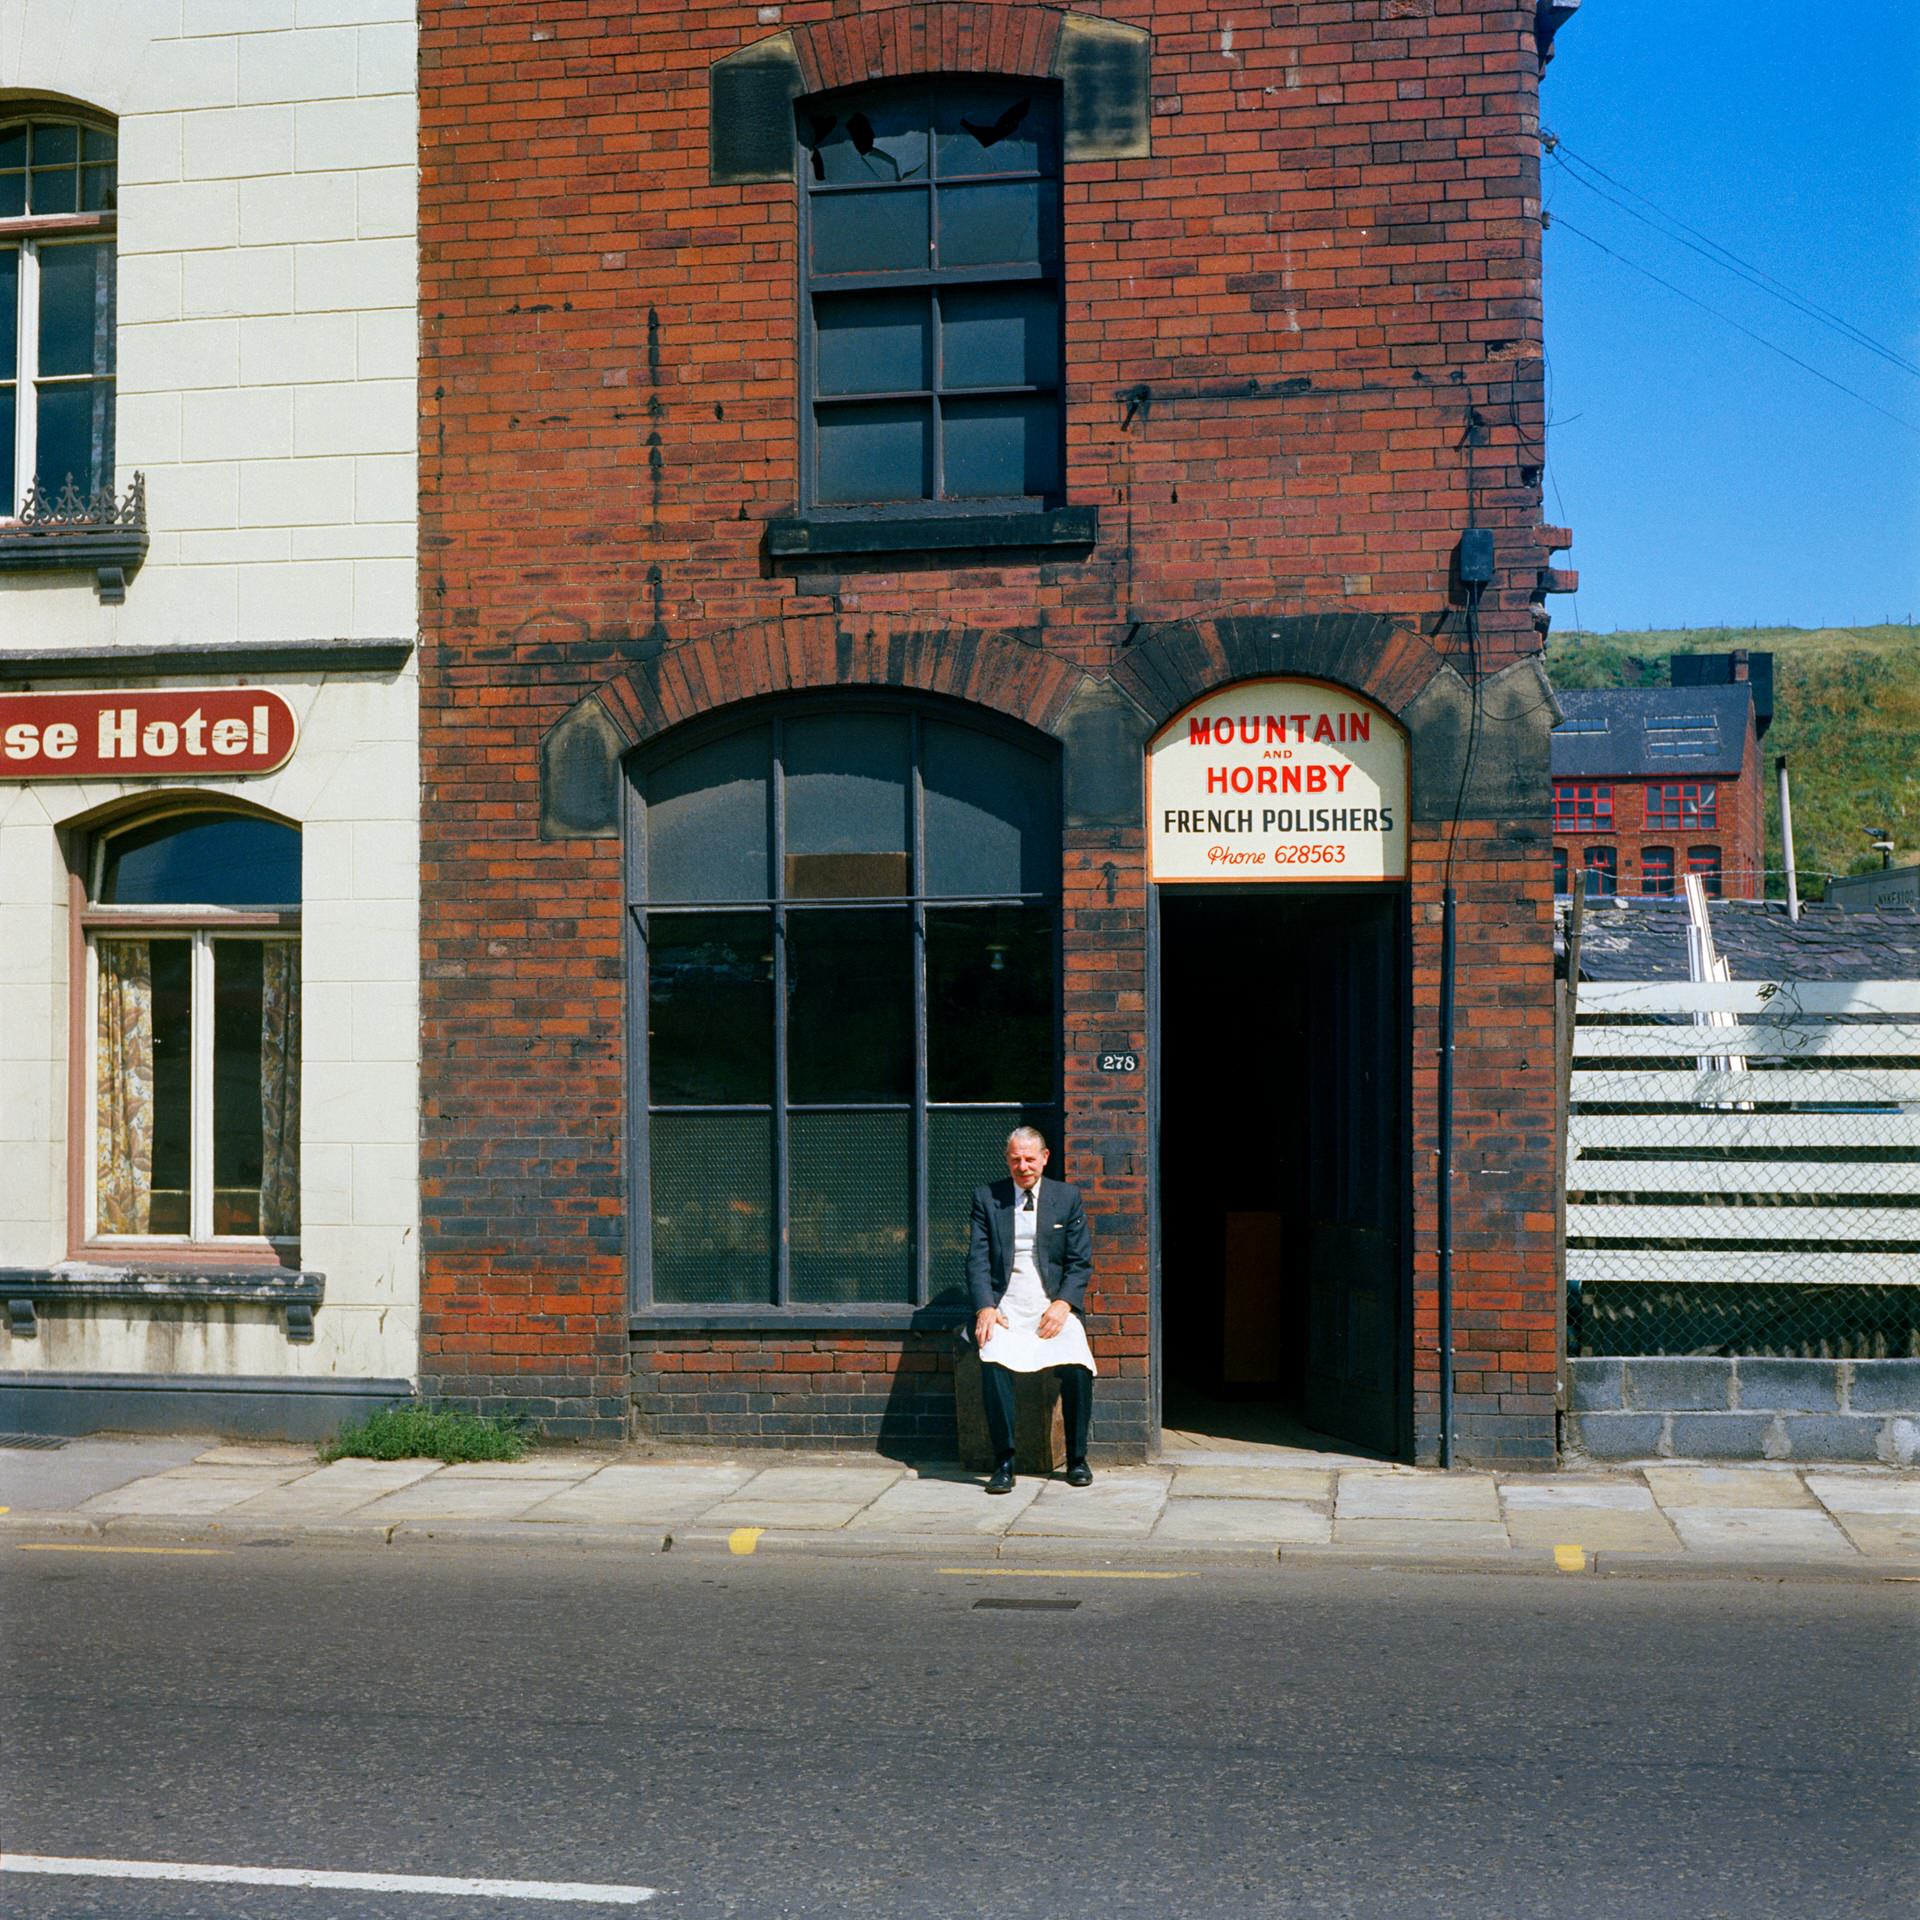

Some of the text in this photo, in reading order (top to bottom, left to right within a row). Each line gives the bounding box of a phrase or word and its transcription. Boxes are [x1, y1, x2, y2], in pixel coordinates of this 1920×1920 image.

[0, 705, 270, 760] se Hotel
[1189, 712, 1371, 746] MOUNTAIN
[1263, 749, 1293, 760] AND
[1207, 764, 1352, 794] HORNBY
[1164, 807, 1393, 834] FRENCH POLISHERS
[1207, 844, 1346, 865] Phone 628563
[1103, 1054, 1136, 1071] 278
